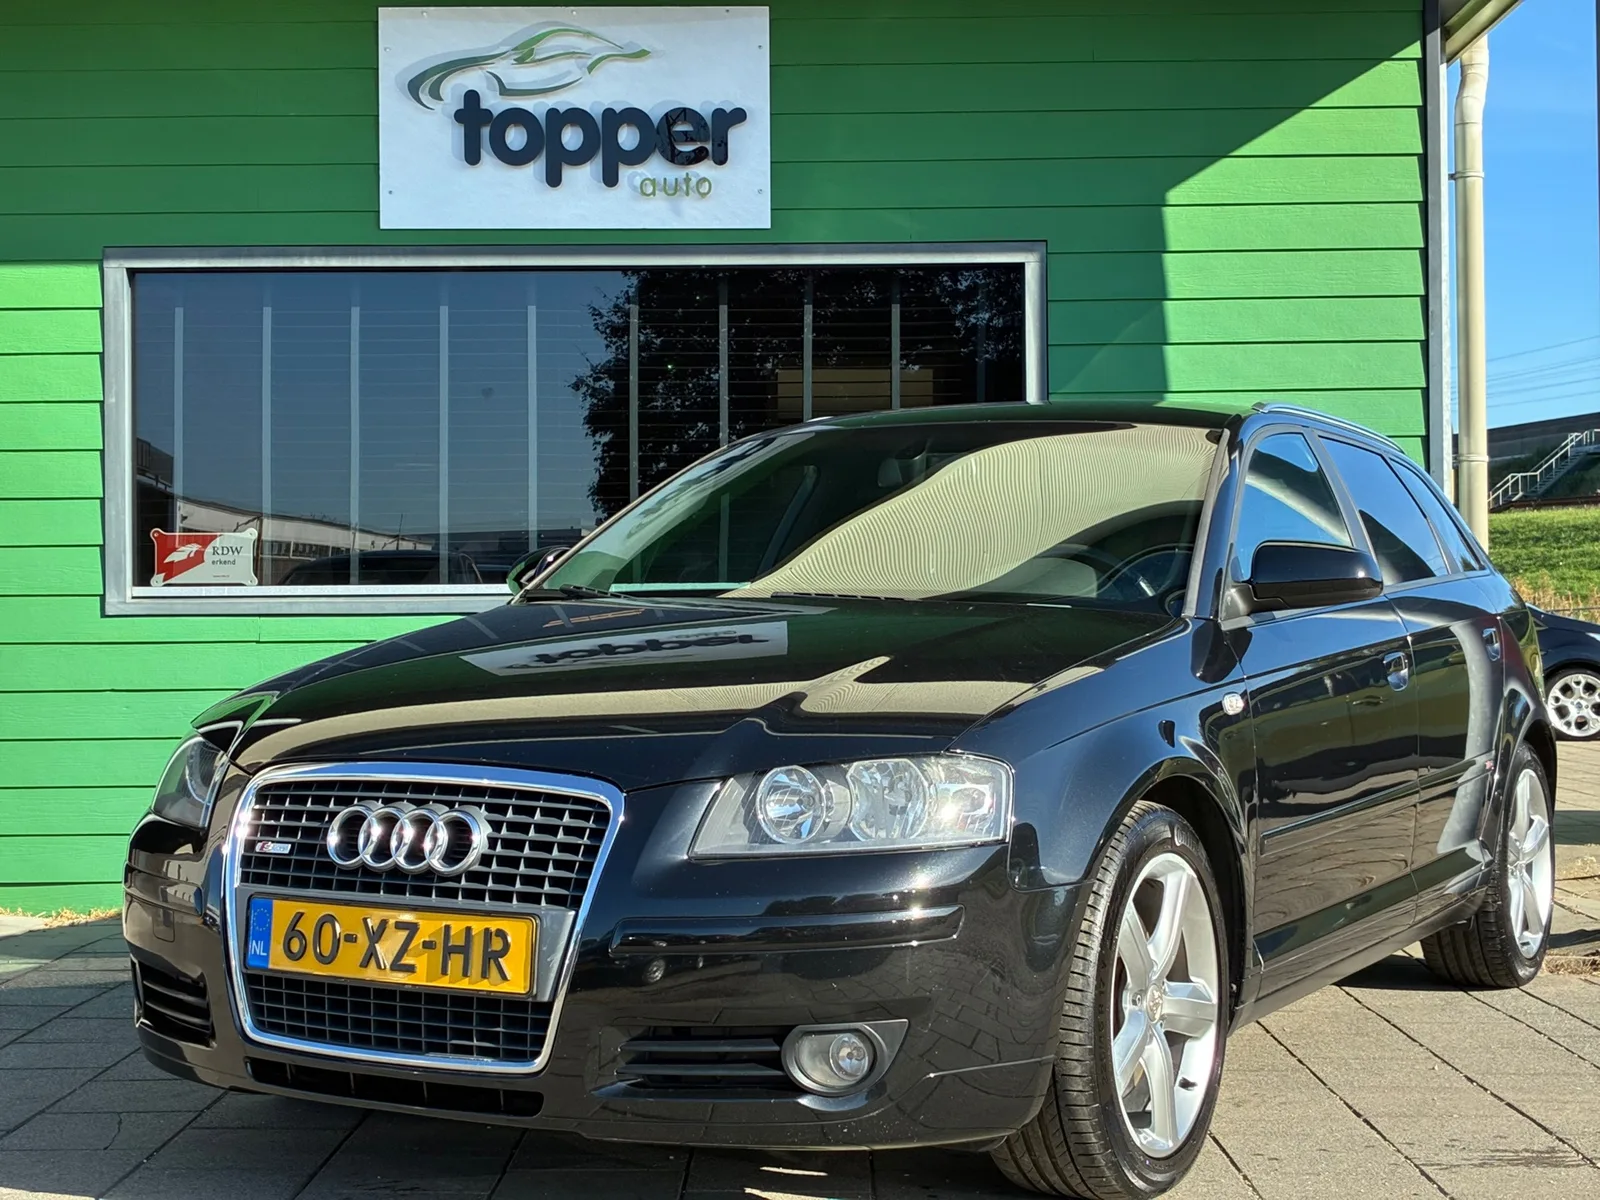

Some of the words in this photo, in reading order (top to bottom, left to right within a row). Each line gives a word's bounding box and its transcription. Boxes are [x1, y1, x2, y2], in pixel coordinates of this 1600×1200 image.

[453, 89, 747, 188] topper
[639, 173, 712, 198] auto
[212, 546, 243, 556] RDW
[211, 558, 236, 566] erkend
[251, 939, 267, 956] NL
[283, 912, 512, 981] 60-XZ-HR
